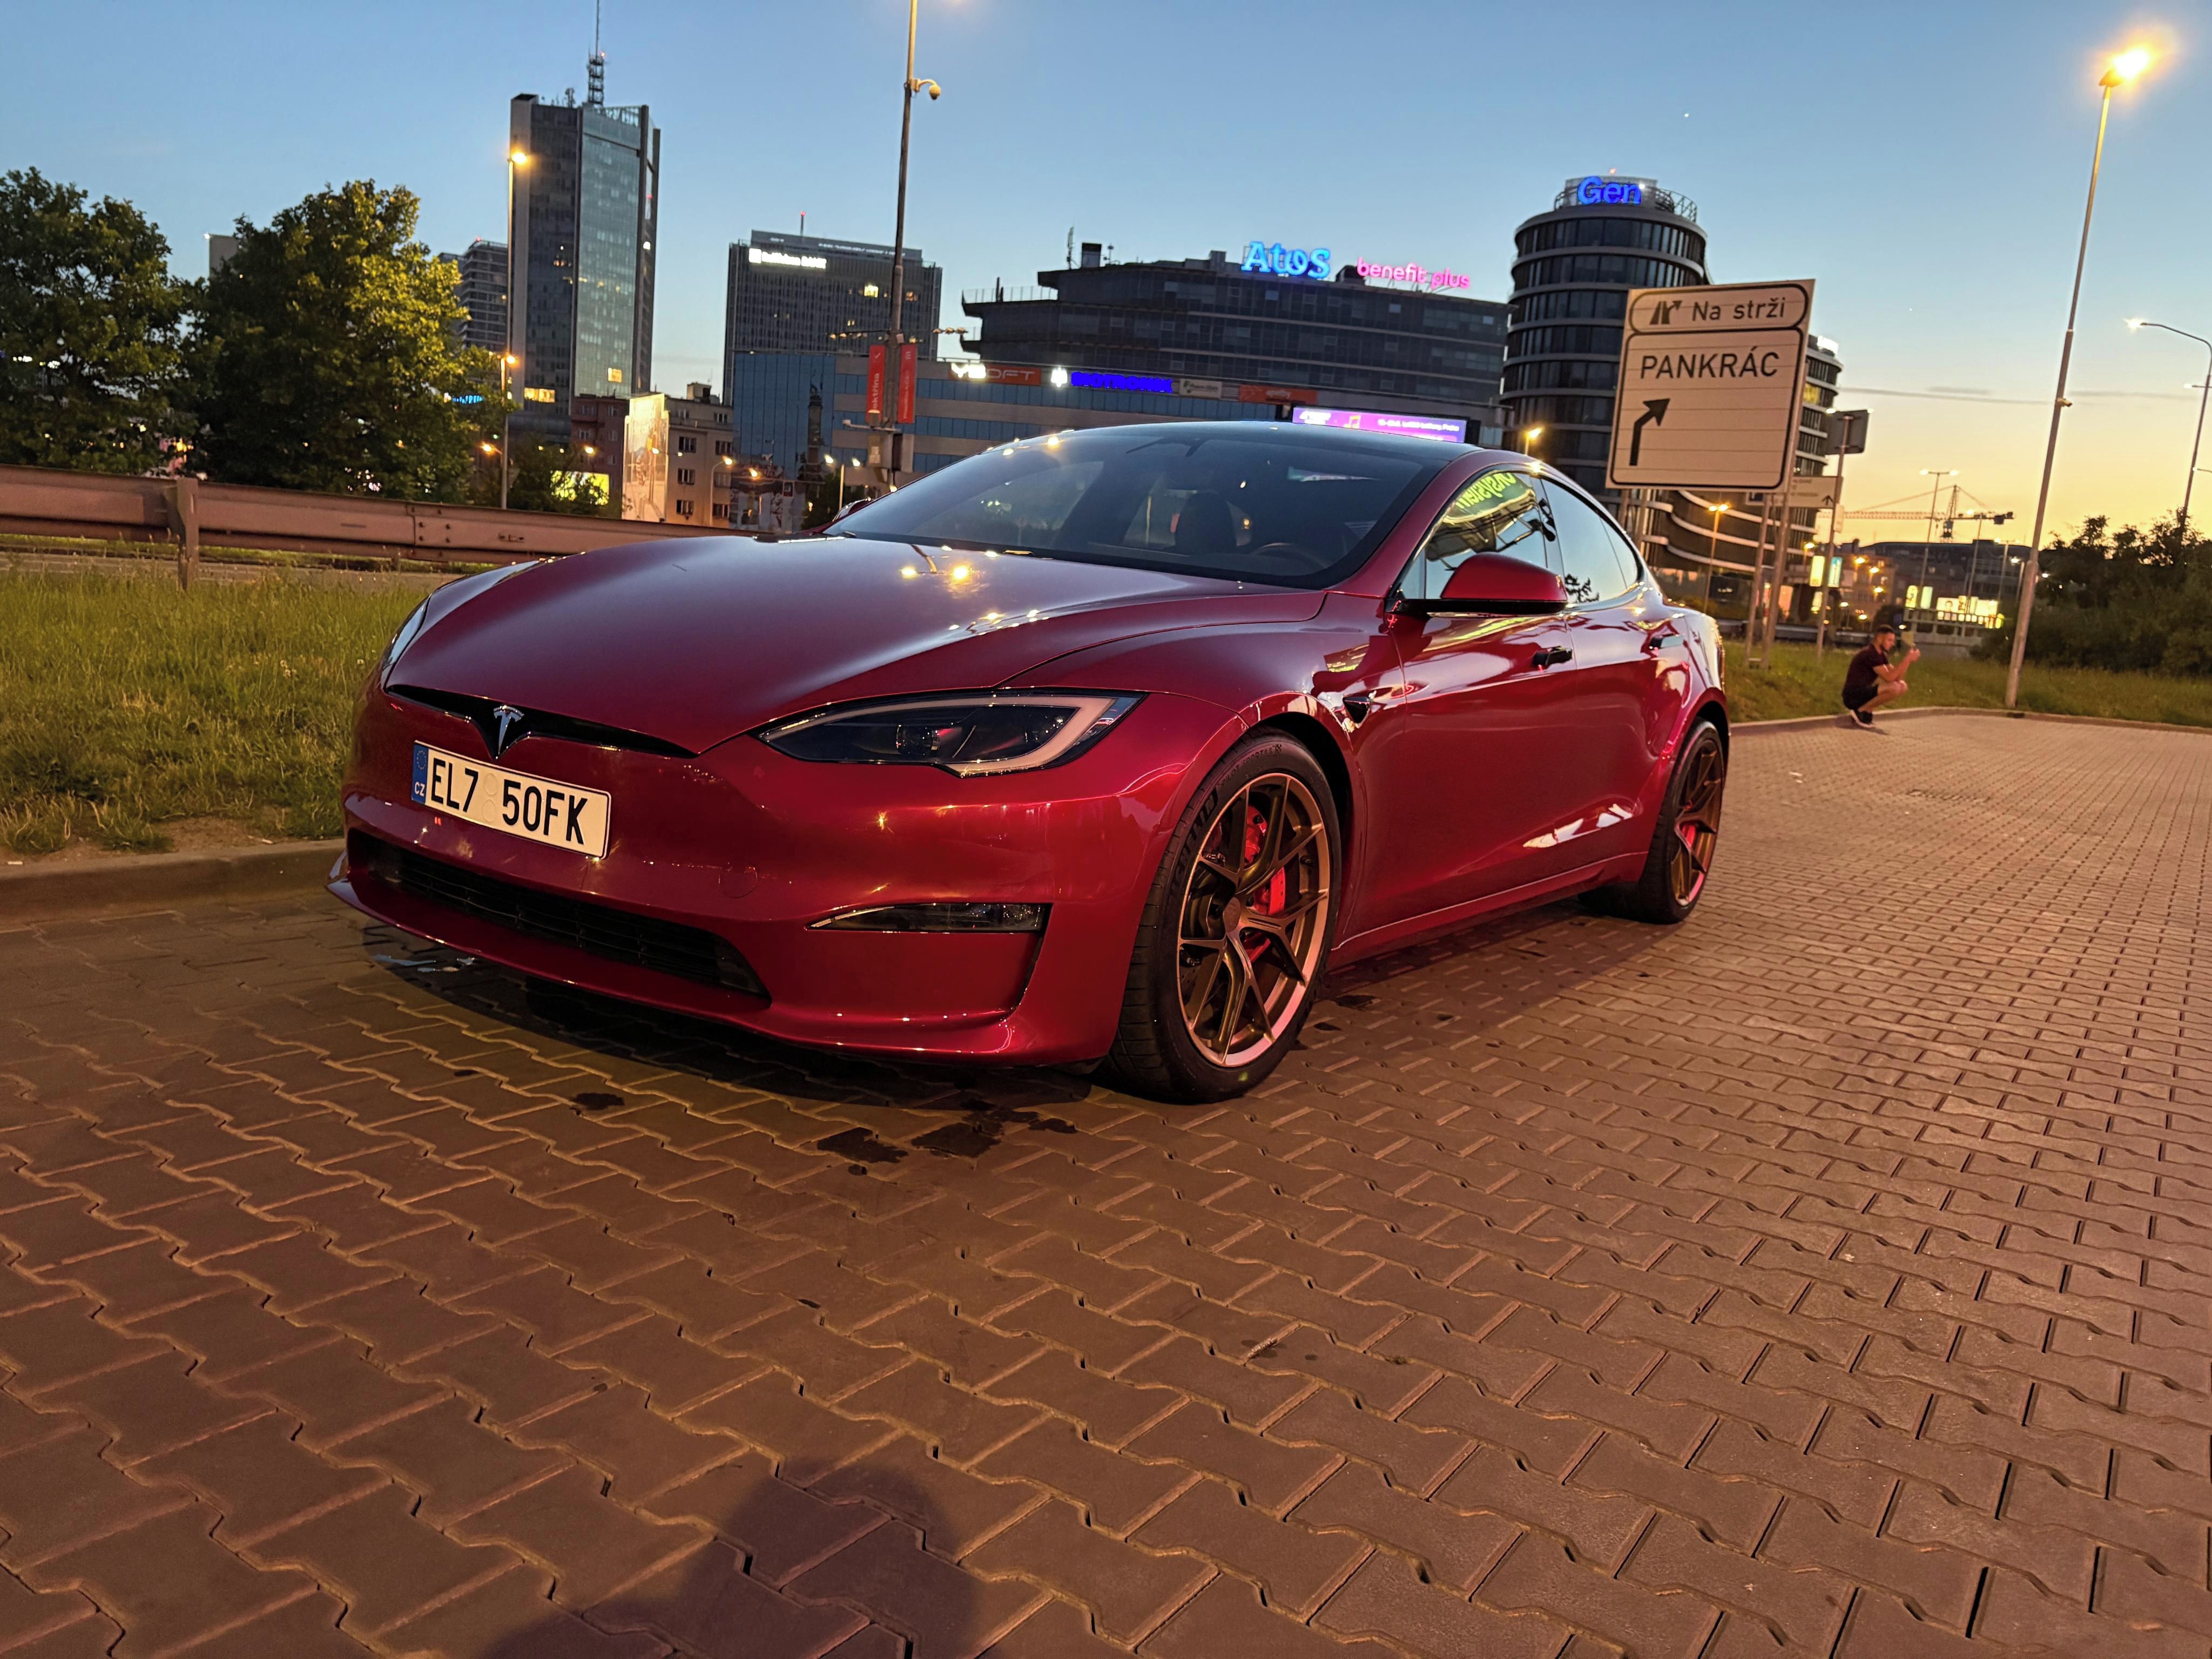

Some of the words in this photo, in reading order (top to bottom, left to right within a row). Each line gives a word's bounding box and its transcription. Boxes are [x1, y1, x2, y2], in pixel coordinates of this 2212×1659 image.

[1577, 176, 1641, 205] Gen
[1357, 257, 1427, 283] benefit
[1430, 268, 1471, 289] plus
[1692, 301, 1721, 321] Na
[1732, 297, 1786, 319] strži
[1641, 346, 1779, 379] PANKRÁC
[414, 781, 425, 797] CZ
[431, 757, 479, 813] EL7
[502, 779, 588, 845] 50FK
